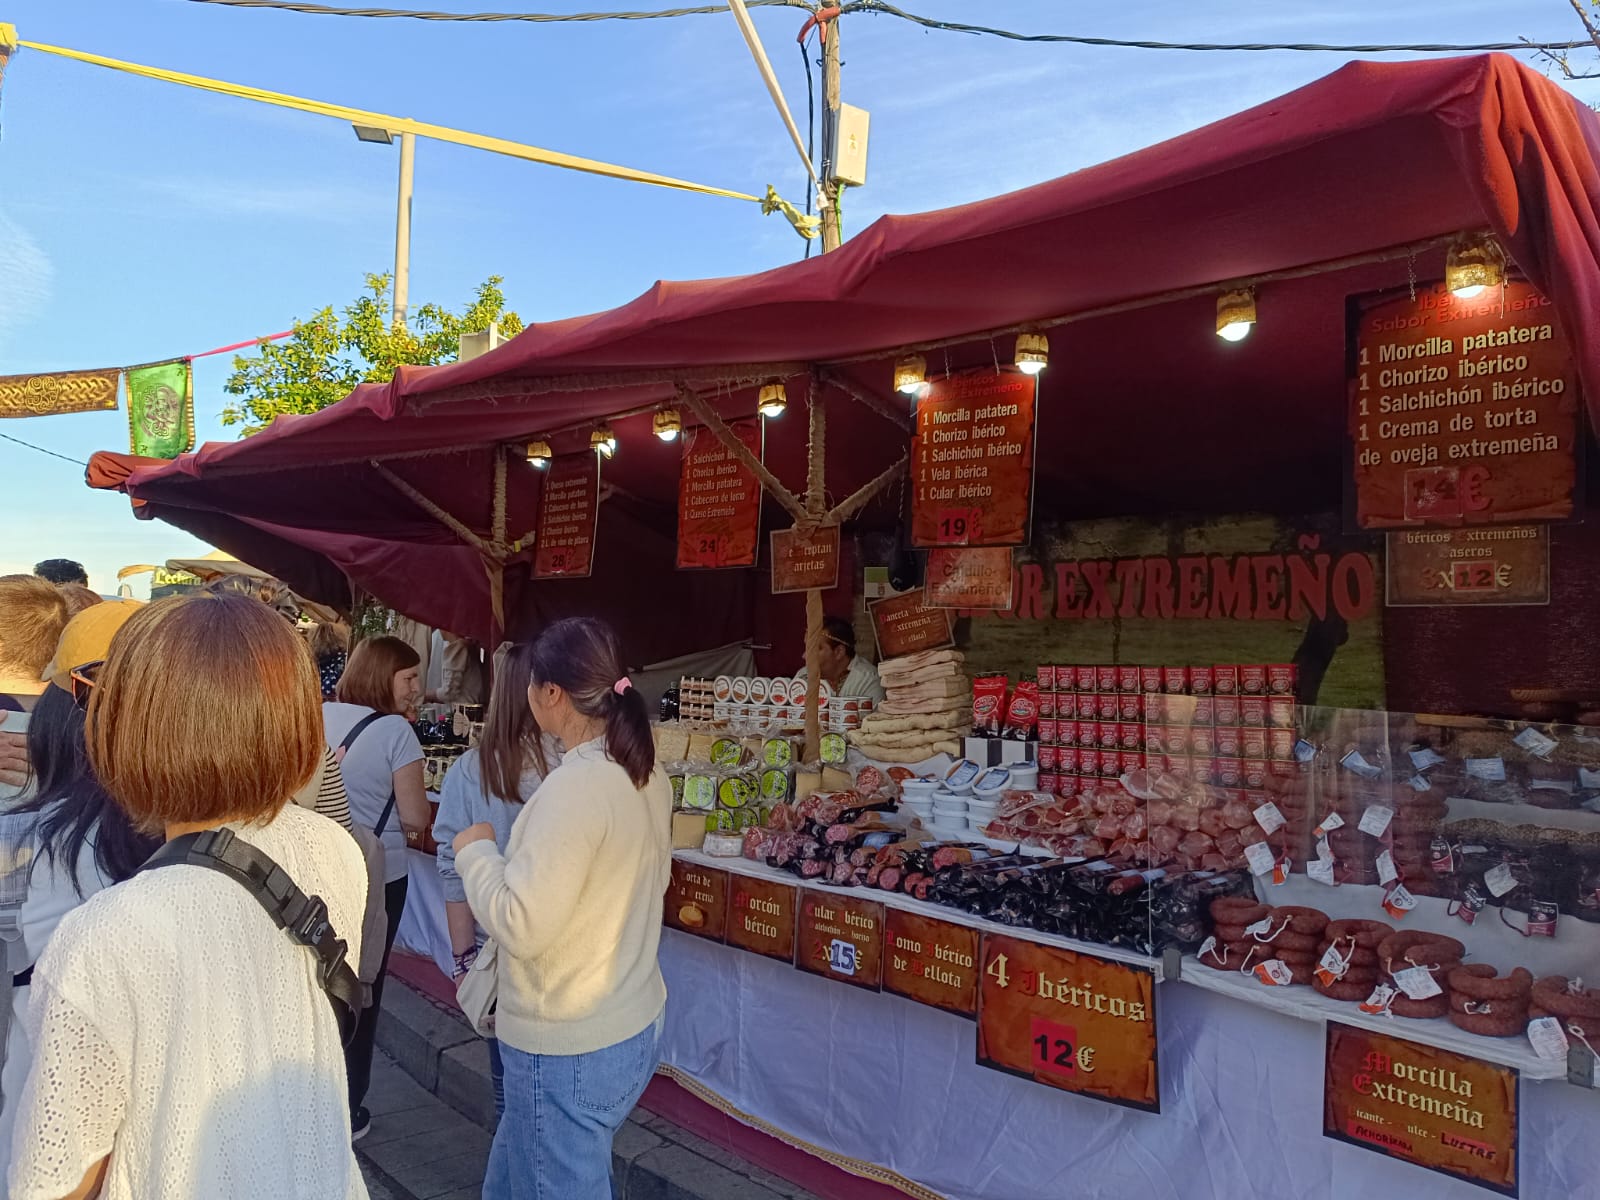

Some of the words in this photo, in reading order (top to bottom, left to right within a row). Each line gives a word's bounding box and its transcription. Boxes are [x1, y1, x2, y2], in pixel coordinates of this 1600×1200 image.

[1371, 314, 1430, 334] Sabor
[1436, 293, 1553, 324] Extremeño
[1360, 347, 1370, 365] 1
[1379, 336, 1453, 363] Morcilla
[1462, 323, 1552, 355] patatera
[1360, 372, 1369, 391] 1
[1379, 365, 1449, 389] Chorizo
[1458, 354, 1528, 379] ibérico
[1360, 397, 1369, 416] 1
[1379, 385, 1483, 414] Salchichón
[1492, 376, 1564, 402] ibérico
[923, 412, 929, 426] 1
[933, 407, 971, 424] Morcilla
[975, 403, 1018, 422] patatera
[1360, 423, 1369, 441] 1
[1379, 419, 1440, 439] Crema
[1450, 412, 1474, 433] de
[1484, 408, 1537, 429] torta
[922, 431, 928, 445] 1
[932, 429, 968, 444] Chorizo
[972, 424, 1006, 440] ibérico
[1359, 448, 1381, 467] de
[1390, 443, 1439, 466] oveja
[1448, 432, 1559, 460] extremeña
[921, 450, 927, 463] 1
[931, 445, 983, 463] Salchichón
[987, 442, 1022, 457] ibérico
[920, 469, 926, 482] 1
[931, 467, 950, 481] Vela
[954, 465, 988, 479] ibérica
[919, 487, 925, 500] 1
[929, 486, 954, 500] Cular
[958, 484, 992, 499] ibérico
[799, 543, 832, 557] ceptan
[1402, 530, 1451, 544] béricos
[791, 559, 825, 573] arjetas
[1054, 533, 1375, 622] EXTREMEÑO
[735, 891, 781, 917] Morcón
[737, 912, 778, 939] Ibérico
[886, 929, 921, 954] Lomo
[926, 941, 973, 968] Ibérico
[893, 954, 907, 972] de
[912, 960, 962, 989] Bellota
[986, 952, 1011, 989] 4
[1018, 968, 1146, 1022] Ibéricos
[1361, 1051, 1474, 1099] Morcilla
[1352, 1072, 1485, 1130] Extremeña
[1352, 1106, 1385, 1126] icante
[1403, 1120, 1429, 1139] ulce
